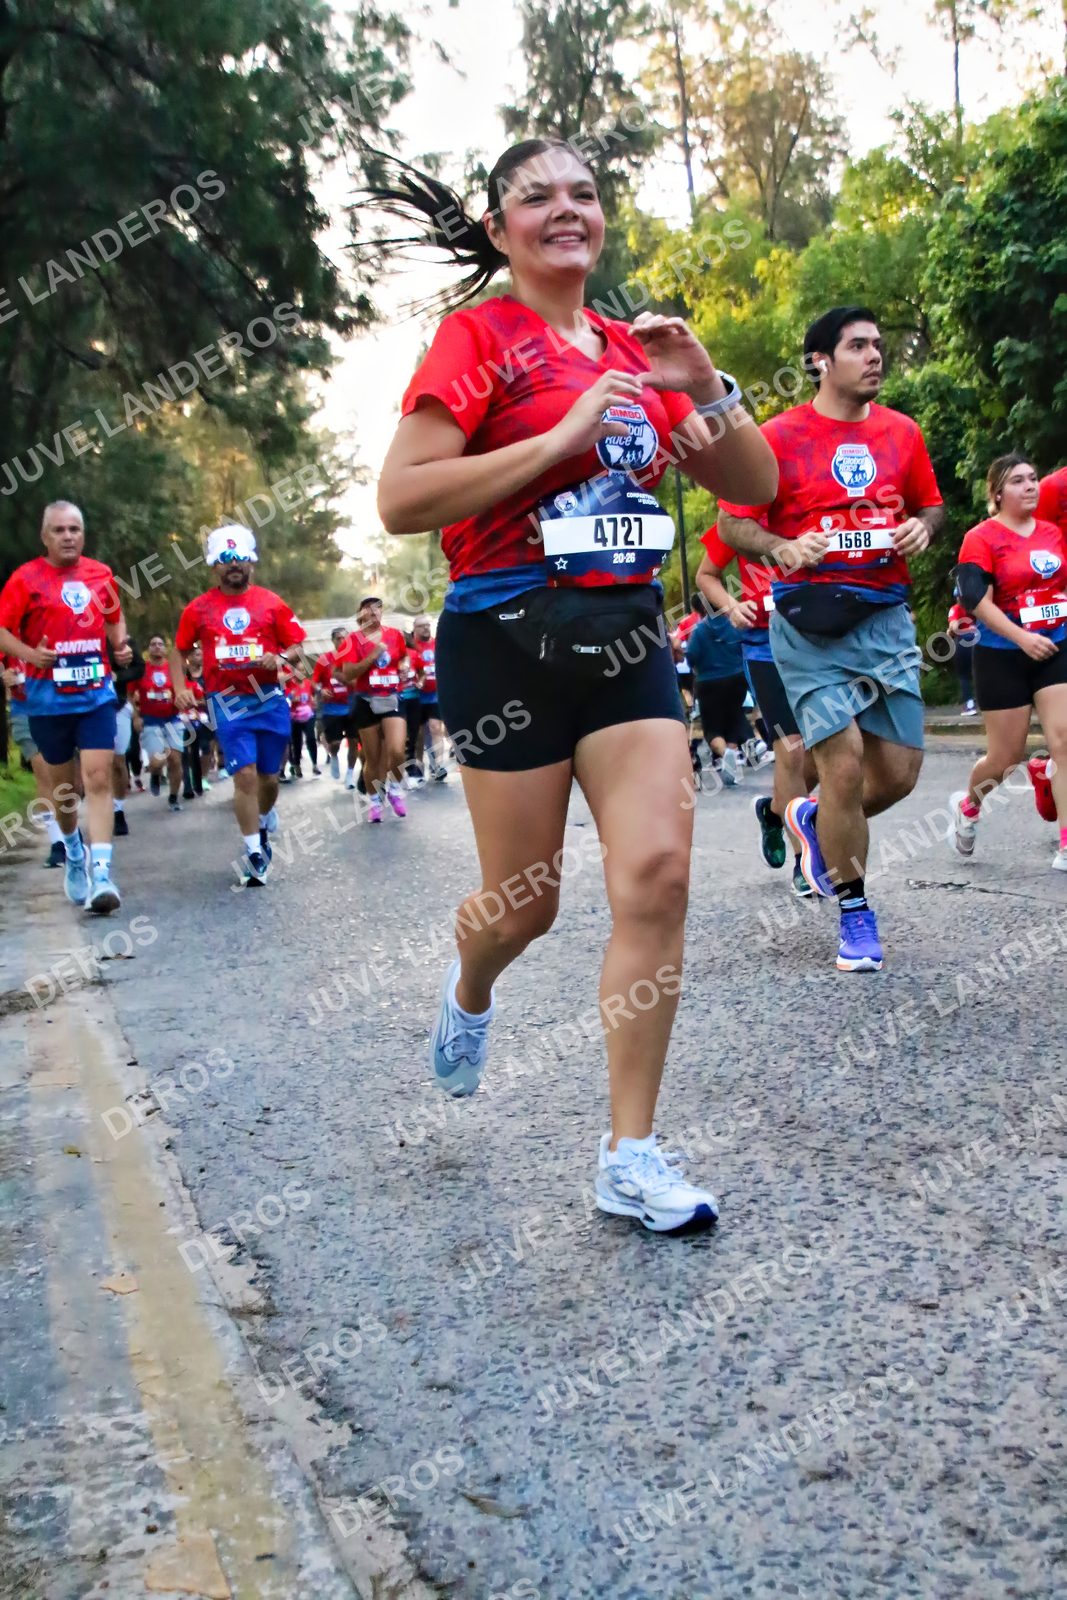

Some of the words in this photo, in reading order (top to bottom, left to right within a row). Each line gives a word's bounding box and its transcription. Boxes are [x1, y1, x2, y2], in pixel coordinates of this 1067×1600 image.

[609, 408, 642, 419] BIMBO
[593, 516, 643, 548] 4727
[837, 531, 872, 549] 1568
[612, 552, 636, 564] 20-26
[1040, 604, 1060, 618] 1515
[228, 644, 250, 657] 2402
[71, 667, 91, 680] 4134
